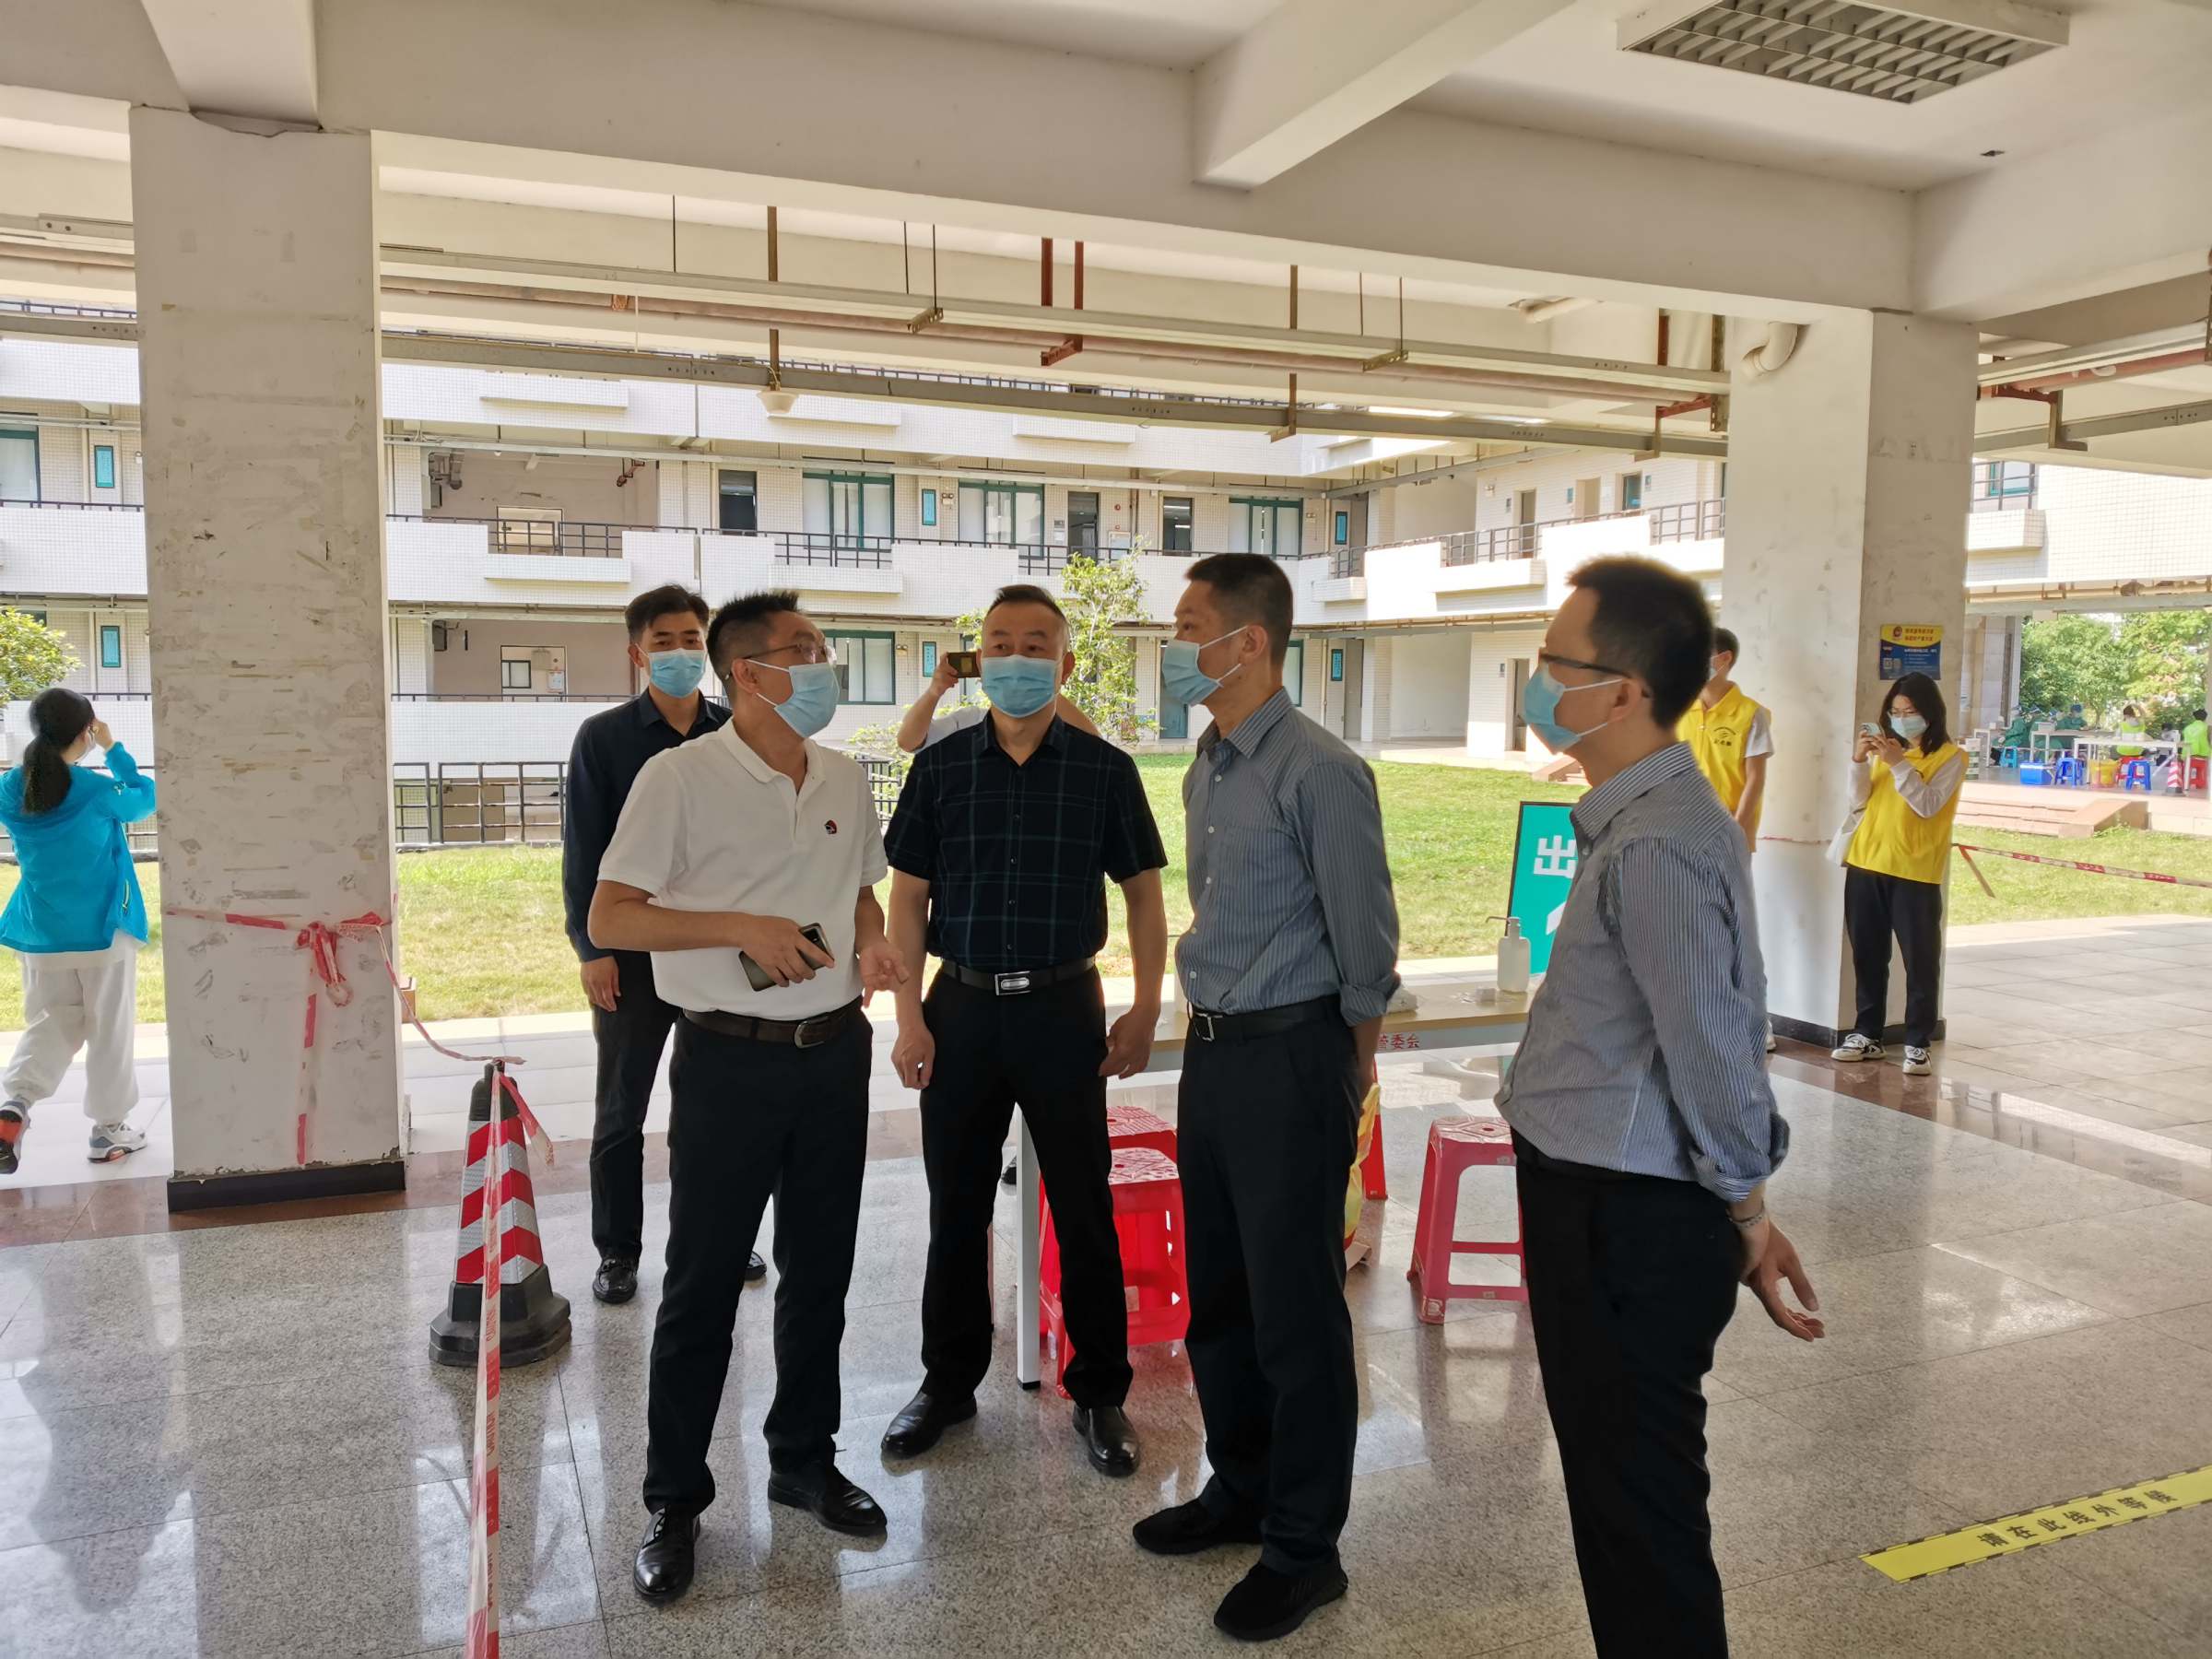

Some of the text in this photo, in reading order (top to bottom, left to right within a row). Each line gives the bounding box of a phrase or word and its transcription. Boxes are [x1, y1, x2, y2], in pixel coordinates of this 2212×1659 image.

[1533, 834, 1577, 879] 出
[1976, 1488, 2178, 1548] 请在此线外等候
